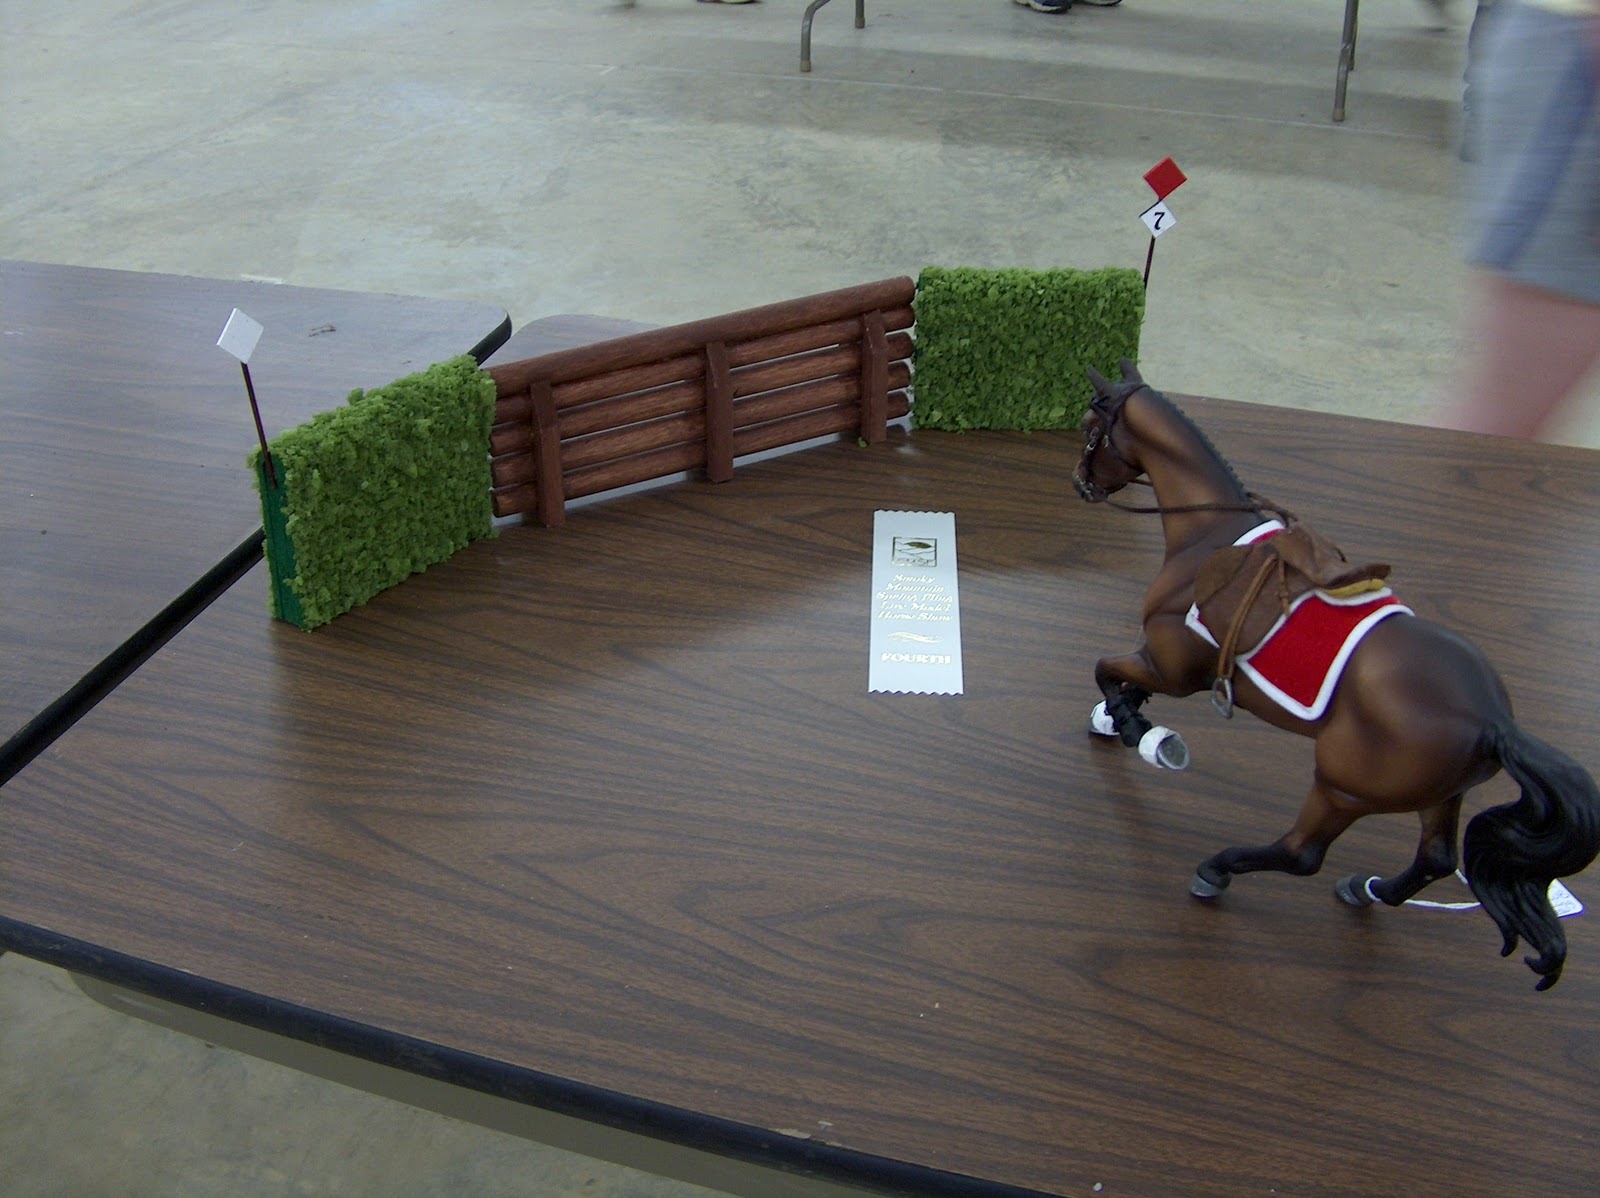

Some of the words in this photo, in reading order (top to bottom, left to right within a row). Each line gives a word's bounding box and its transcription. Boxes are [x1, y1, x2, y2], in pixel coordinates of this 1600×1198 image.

[1154, 212, 1165, 230] 7
[893, 574, 935, 583] Smoky
[886, 582, 944, 592] Mountain
[876, 592, 918, 602] Spring
[917, 612, 952, 621] Show
[881, 652, 951, 664] FOURTH
